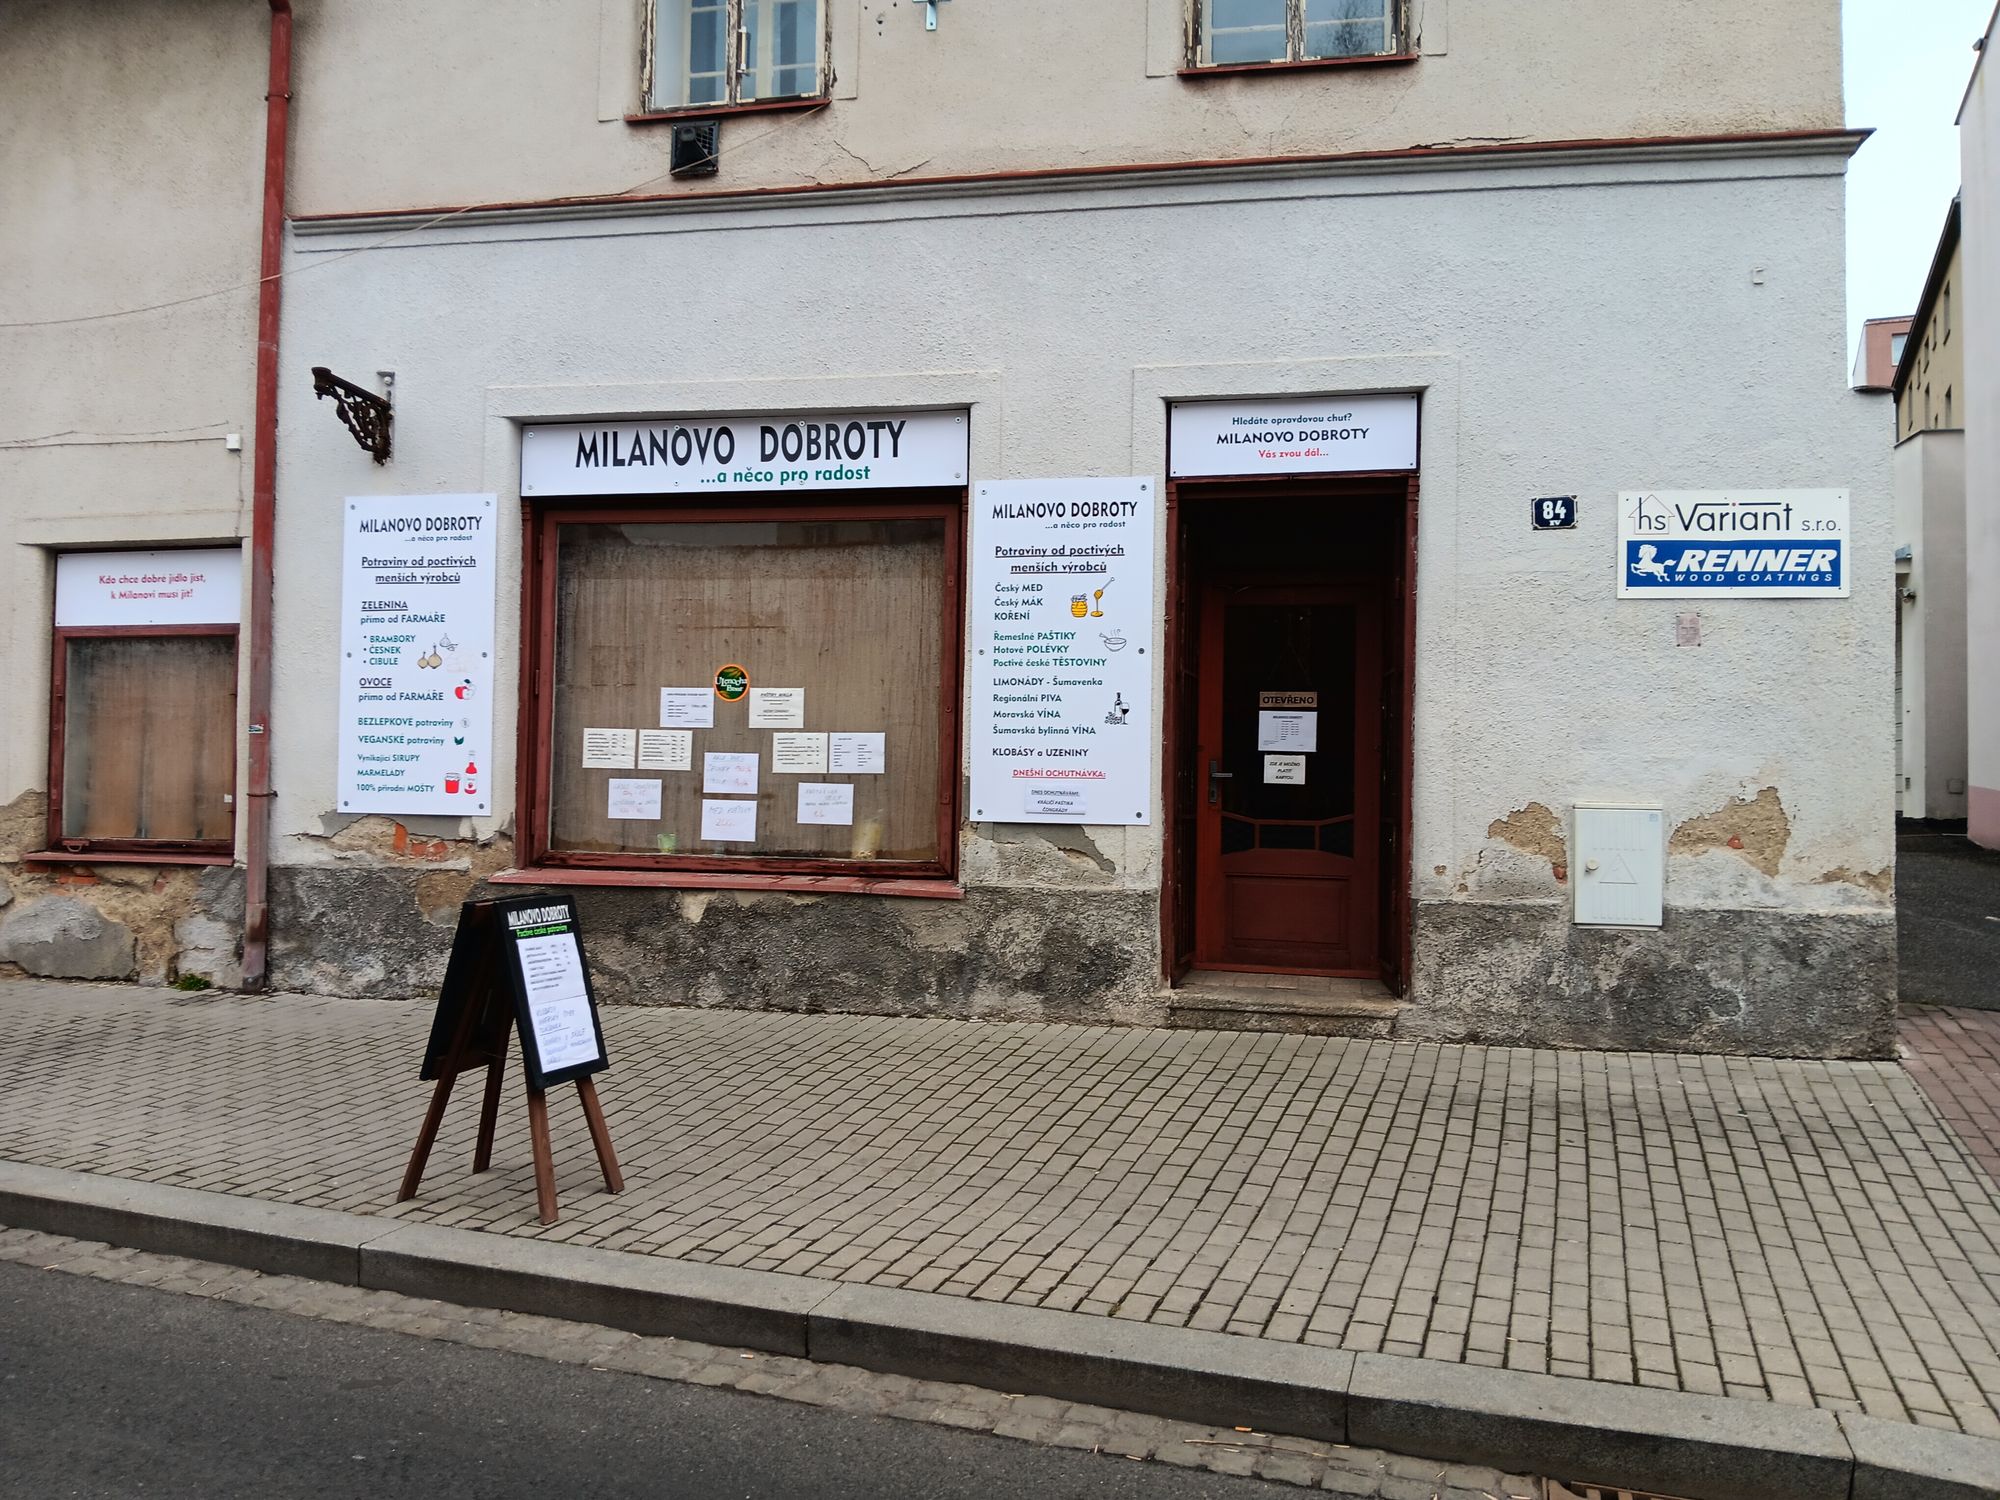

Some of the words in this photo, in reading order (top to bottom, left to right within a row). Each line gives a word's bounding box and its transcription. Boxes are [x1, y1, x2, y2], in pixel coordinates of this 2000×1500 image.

[1232, 416, 1268, 425] Hledáte
[1271, 415, 1323, 426] opravdovou
[1328, 413, 1352, 422] chuť?
[1217, 432, 1294, 444] MILANOVO
[1299, 428, 1369, 442] DOBROTY
[575, 426, 735, 468] MILANOVO
[760, 420, 907, 463] DOBROTY
[1259, 450, 1276, 458] Vás
[1280, 450, 1301, 458] zvou
[1304, 448, 1328, 457] dál...
[701, 472, 727, 483] ...a
[733, 466, 774, 483] něco
[780, 469, 807, 485] pro
[815, 465, 871, 481] radost
[992, 502, 1065, 518] MILANOVO
[1071, 501, 1137, 517] DOBROTY
[1543, 500, 1566, 519] 84
[1638, 497, 1666, 530] hs
[1675, 502, 1793, 532] Variant
[1801, 519, 1841, 532] s.r.o.
[360, 518, 422, 532] MILANOVO
[426, 516, 482, 531] DOBROTY
[1061, 521, 1080, 529] něco
[995, 546, 1047, 557] Potraviny
[1051, 545, 1065, 556] od
[1069, 544, 1124, 557] poctivých
[362, 557, 407, 568] Potraviny
[411, 556, 424, 566] od
[428, 556, 476, 568] poctivých
[1676, 549, 1838, 572] RENNER
[1010, 562, 1058, 572] menších
[1062, 561, 1107, 574] výrobců
[99, 575, 116, 584] Kdo
[119, 575, 138, 583] chce
[375, 572, 417, 582] menších
[421, 572, 460, 584] výrobců
[1674, 574, 1725, 582] WOOD
[1738, 573, 1833, 582] COATINGS
[995, 582, 1019, 593] Český
[1022, 584, 1043, 592] MED
[119, 590, 155, 599] Milanovi
[361, 601, 408, 609] ZELENINA
[995, 597, 1019, 608] Český
[1021, 597, 1043, 606] MÁK
[388, 615, 398, 623] od
[401, 612, 445, 623] FARMÁŘE
[994, 610, 1030, 620] KOŘENÍ
[370, 635, 415, 643] BRAMBORY
[994, 631, 1035, 641] Řemeslné
[1037, 630, 1076, 640] PAŠTIKY
[993, 645, 1024, 654] Hotové
[1027, 643, 1069, 653] POLÉVKY
[993, 658, 1024, 667] Poctivé
[1026, 658, 1050, 667] české
[1052, 657, 1107, 666] TĚSTOVINY
[359, 678, 392, 686] OVOCE
[993, 676, 1044, 686] LIMONÁDY
[1053, 675, 1103, 686] Šumavenka
[358, 693, 383, 702] přímo
[386, 692, 396, 700] od
[400, 690, 444, 700] FARMÁŘE
[993, 694, 1038, 704] Regionální
[1041, 694, 1062, 702] PIVA
[1263, 695, 1314, 704] OTEVŘENO
[993, 710, 1034, 718] Moravská
[1037, 708, 1061, 718] VÍNA
[416, 718, 453, 728] potraviny
[993, 724, 1035, 734] Šumavská
[1038, 726, 1069, 736] bylinná
[1072, 725, 1096, 734] VÍNA
[407, 736, 444, 746] potraviny
[992, 747, 1035, 756] KLOBÁSY
[1046, 749, 1088, 757] UZENINY
[1013, 769, 1044, 777] DNEŠNÍ
[1046, 769, 1106, 777] OCHUTNÁVKA:
[407, 783, 435, 792] MOŠTY
[507, 908, 541, 926] MILANOVO
[541, 905, 569, 921] DOBROTY
